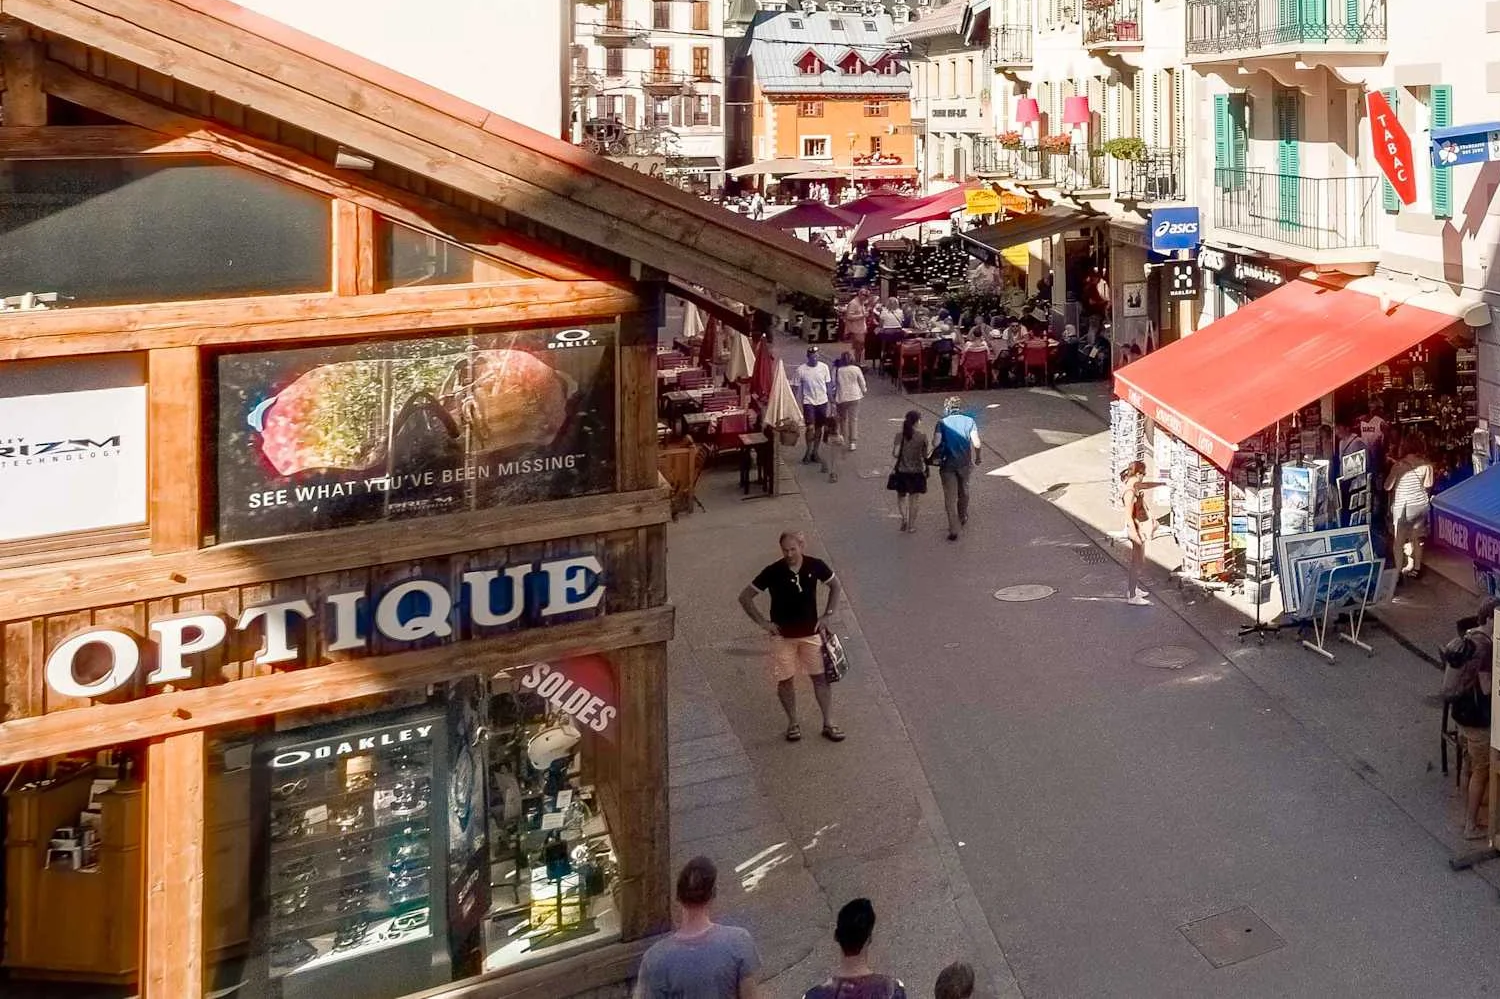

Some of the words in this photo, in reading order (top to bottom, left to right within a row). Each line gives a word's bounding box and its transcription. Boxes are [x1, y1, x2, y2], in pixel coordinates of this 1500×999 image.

[1377, 115, 1408, 182] TABAC
[547, 339, 598, 349] OAKLEY
[0, 435, 120, 458] RIZM
[249, 489, 287, 509] SEE
[295, 481, 357, 502] WHAT
[442, 465, 490, 484] BEEN
[45, 554, 608, 698] OPTIQUE
[521, 661, 618, 733] SOLDES
[314, 724, 434, 760] OAKLEY
